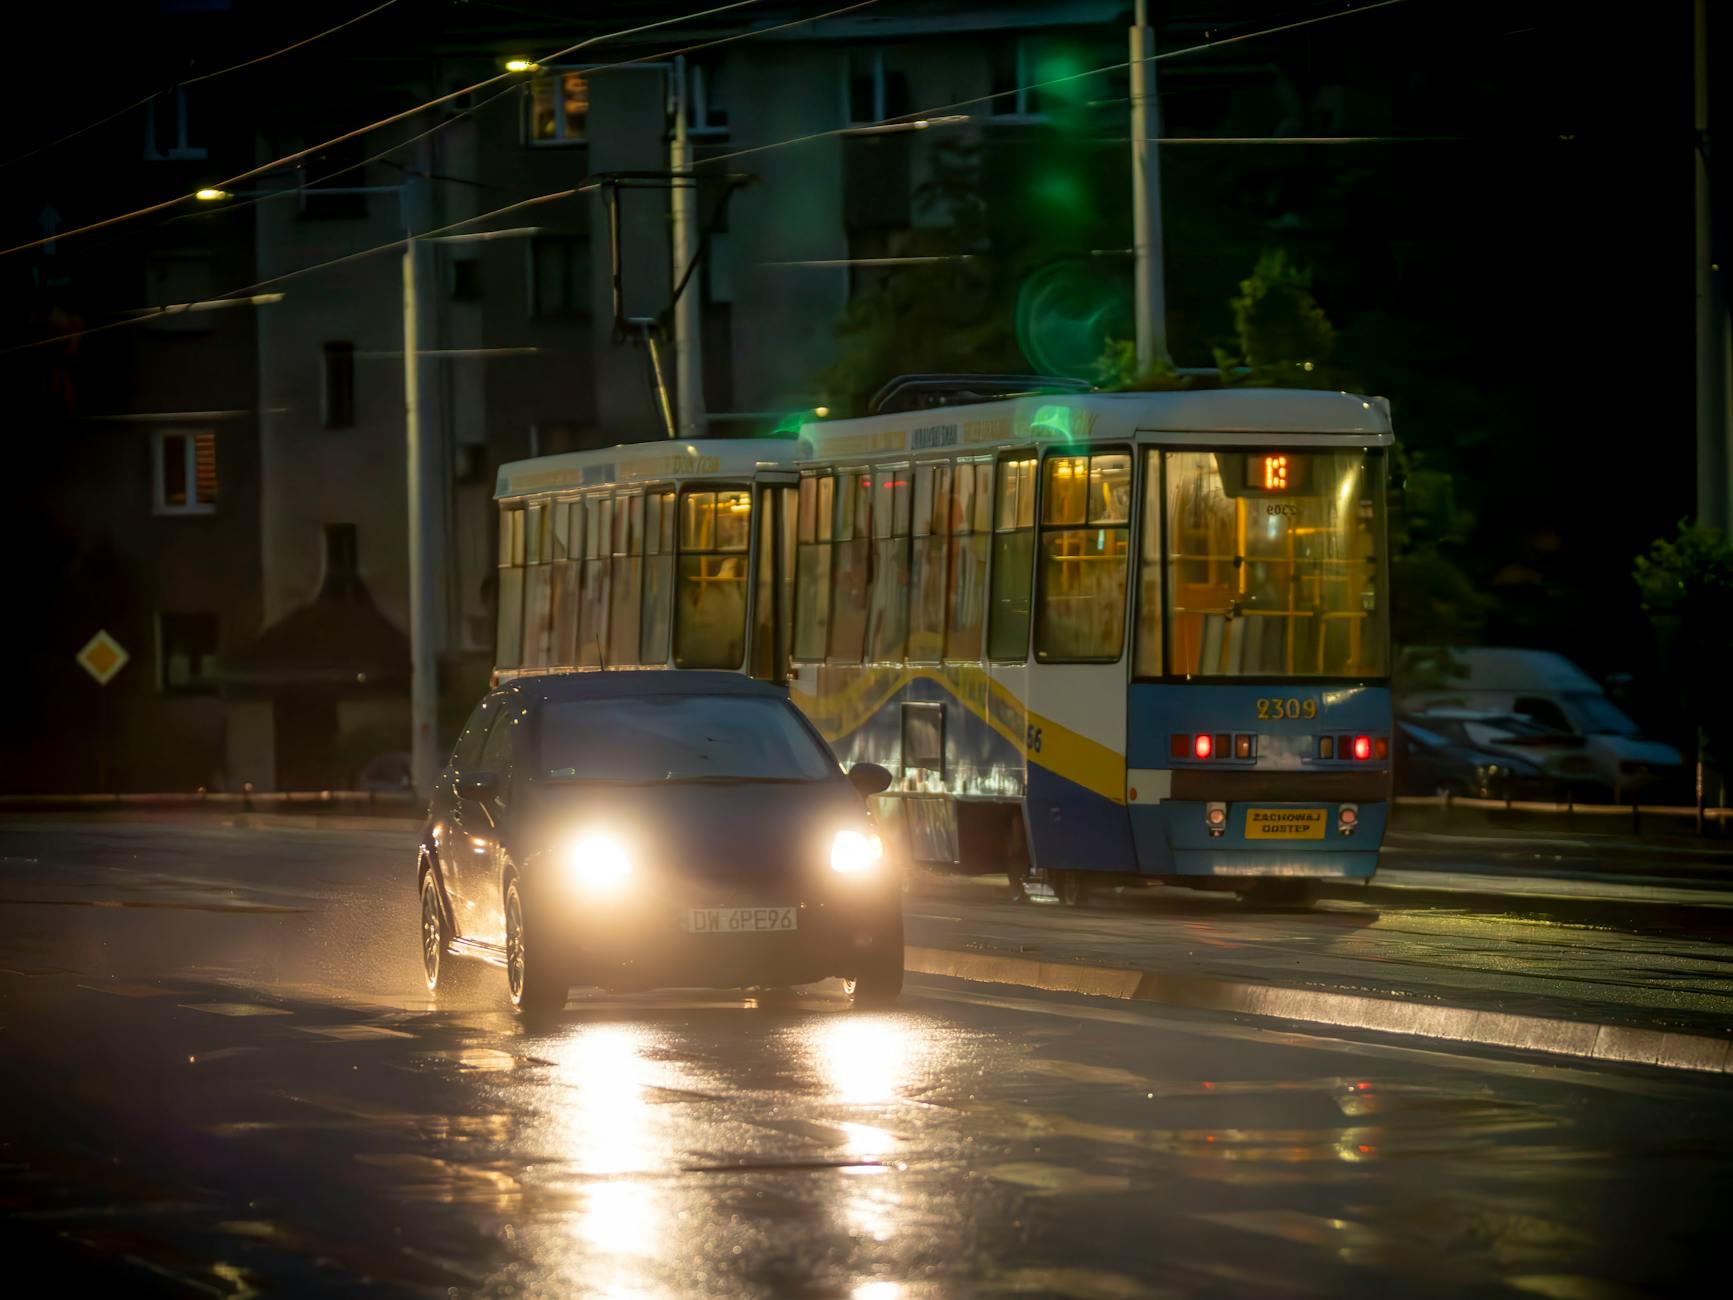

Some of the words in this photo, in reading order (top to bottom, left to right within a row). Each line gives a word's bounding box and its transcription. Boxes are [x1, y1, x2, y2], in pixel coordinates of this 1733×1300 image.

[1256, 699, 1317, 720] 2309
[1252, 813, 1321, 822] ZACHOWAJ
[729, 909, 793, 930] 6PE96
